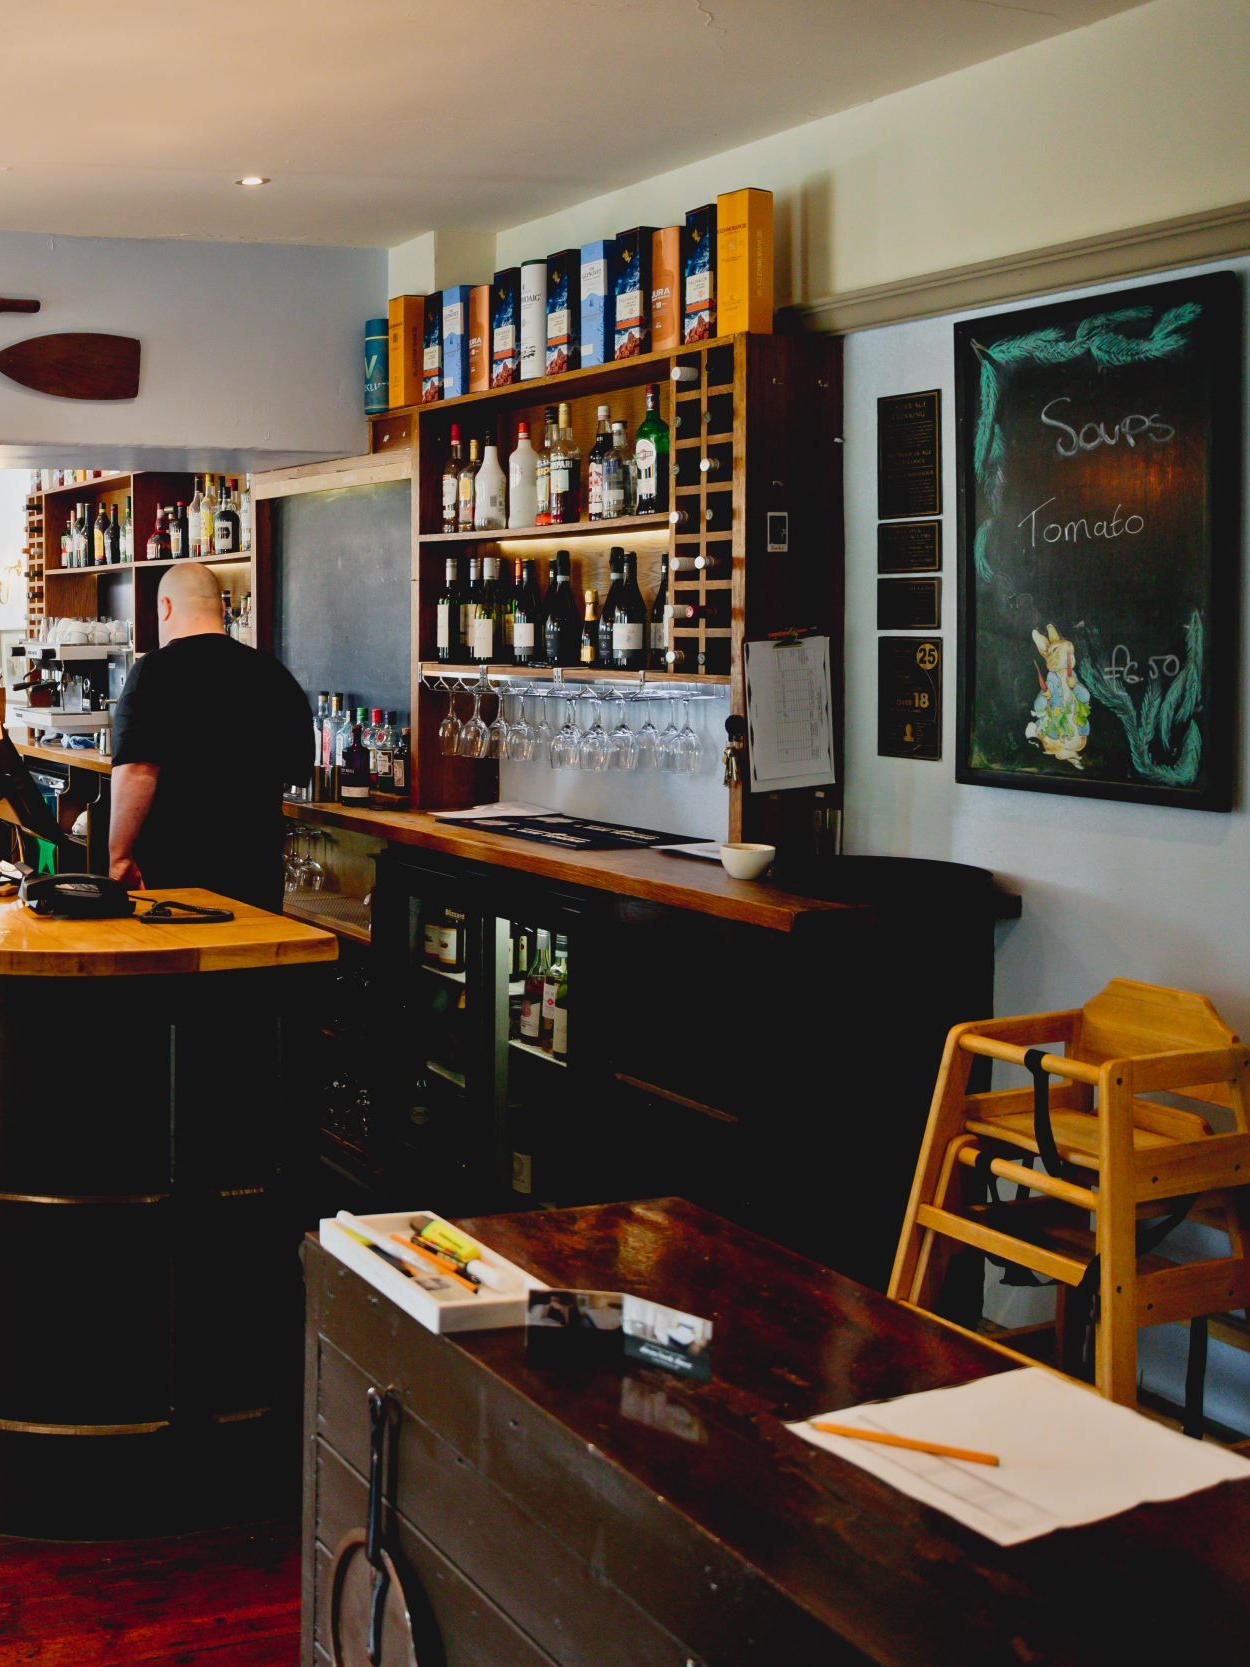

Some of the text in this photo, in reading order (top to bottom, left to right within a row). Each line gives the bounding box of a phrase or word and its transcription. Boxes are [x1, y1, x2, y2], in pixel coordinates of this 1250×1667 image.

[1018, 498, 1145, 552] Tomato
[918, 648, 936, 664] 25
[913, 692, 929, 708] 18
